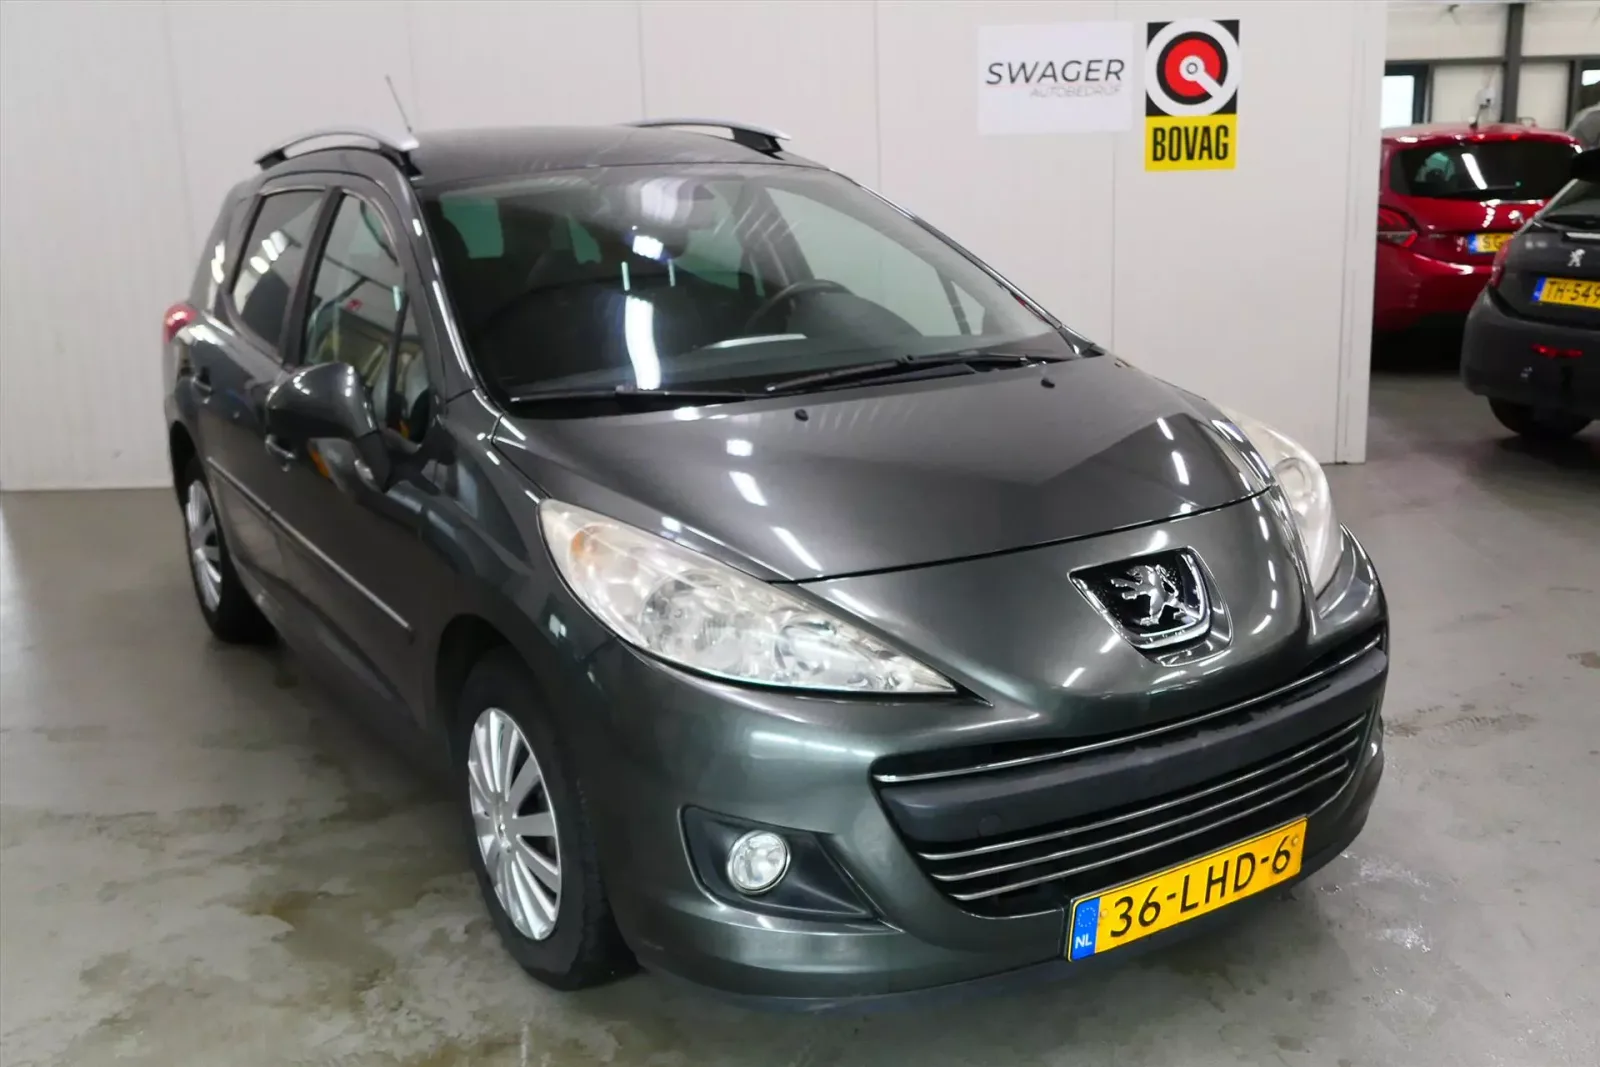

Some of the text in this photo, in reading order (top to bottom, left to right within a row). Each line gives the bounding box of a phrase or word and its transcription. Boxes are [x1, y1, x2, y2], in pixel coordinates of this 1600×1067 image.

[986, 59, 1125, 85] SWAGER
[1152, 125, 1229, 161] BOVAG
[1110, 835, 1292, 938] 36-LHD-6
[1075, 934, 1092, 949] NL
